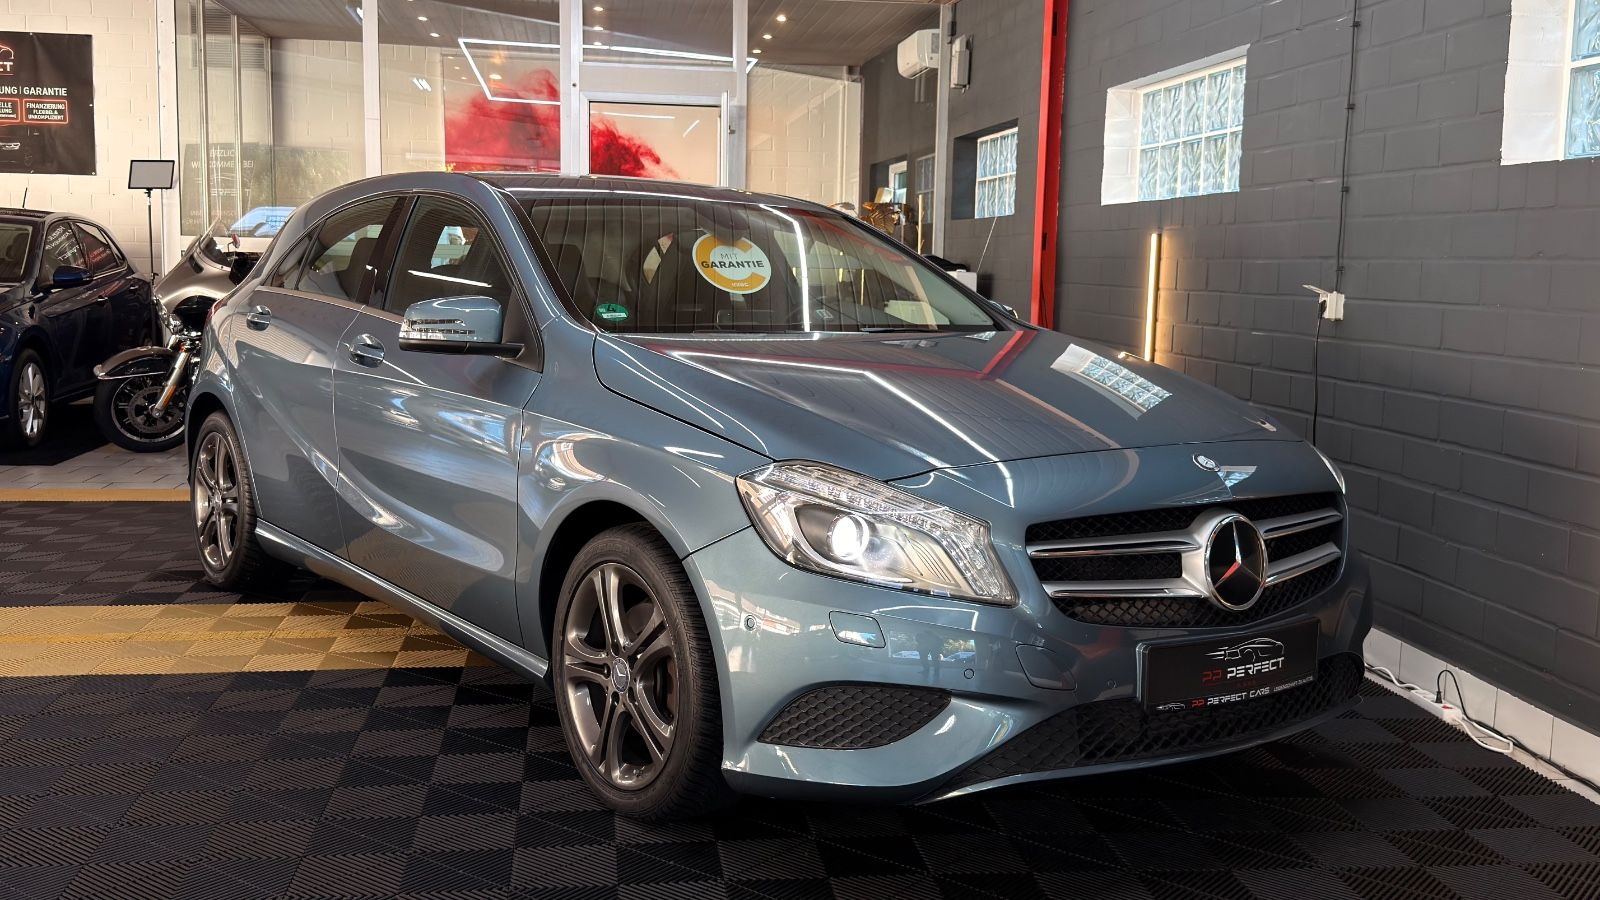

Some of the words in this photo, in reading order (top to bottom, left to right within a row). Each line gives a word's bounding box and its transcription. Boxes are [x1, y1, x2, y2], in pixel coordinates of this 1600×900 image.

[23, 86, 68, 96] GARANTIE
[720, 252, 738, 261] MIT
[701, 260, 765, 269] GARANTIE
[1226, 656, 1285, 680] PERFECT
[1207, 692, 1247, 706] PERFECT
[1249, 687, 1270, 698] CARS
